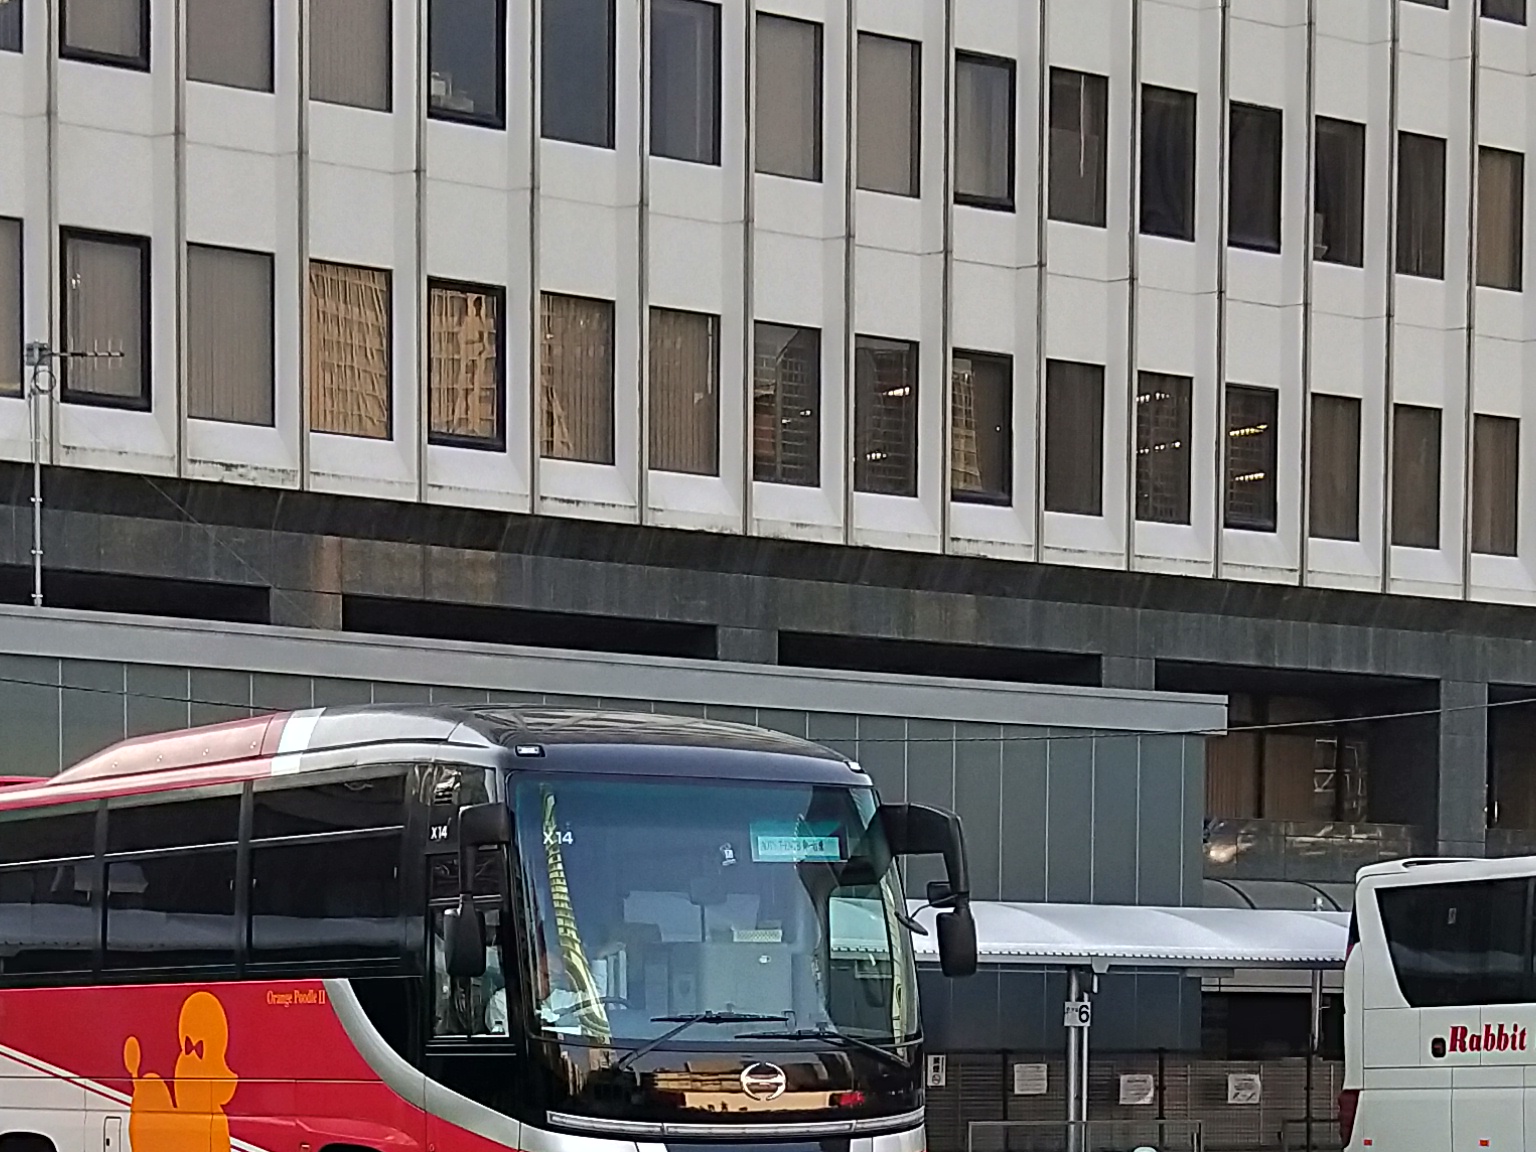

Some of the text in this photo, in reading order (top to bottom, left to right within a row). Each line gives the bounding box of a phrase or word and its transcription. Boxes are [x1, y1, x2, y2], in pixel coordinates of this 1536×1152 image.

[430, 826, 448, 840] X14
[543, 831, 574, 845] X14
[266, 989, 293, 1008] Orange
[294, 989, 318, 1004] Poodle
[1078, 1004, 1090, 1024] 6
[1448, 1023, 1527, 1053] Rabbit
